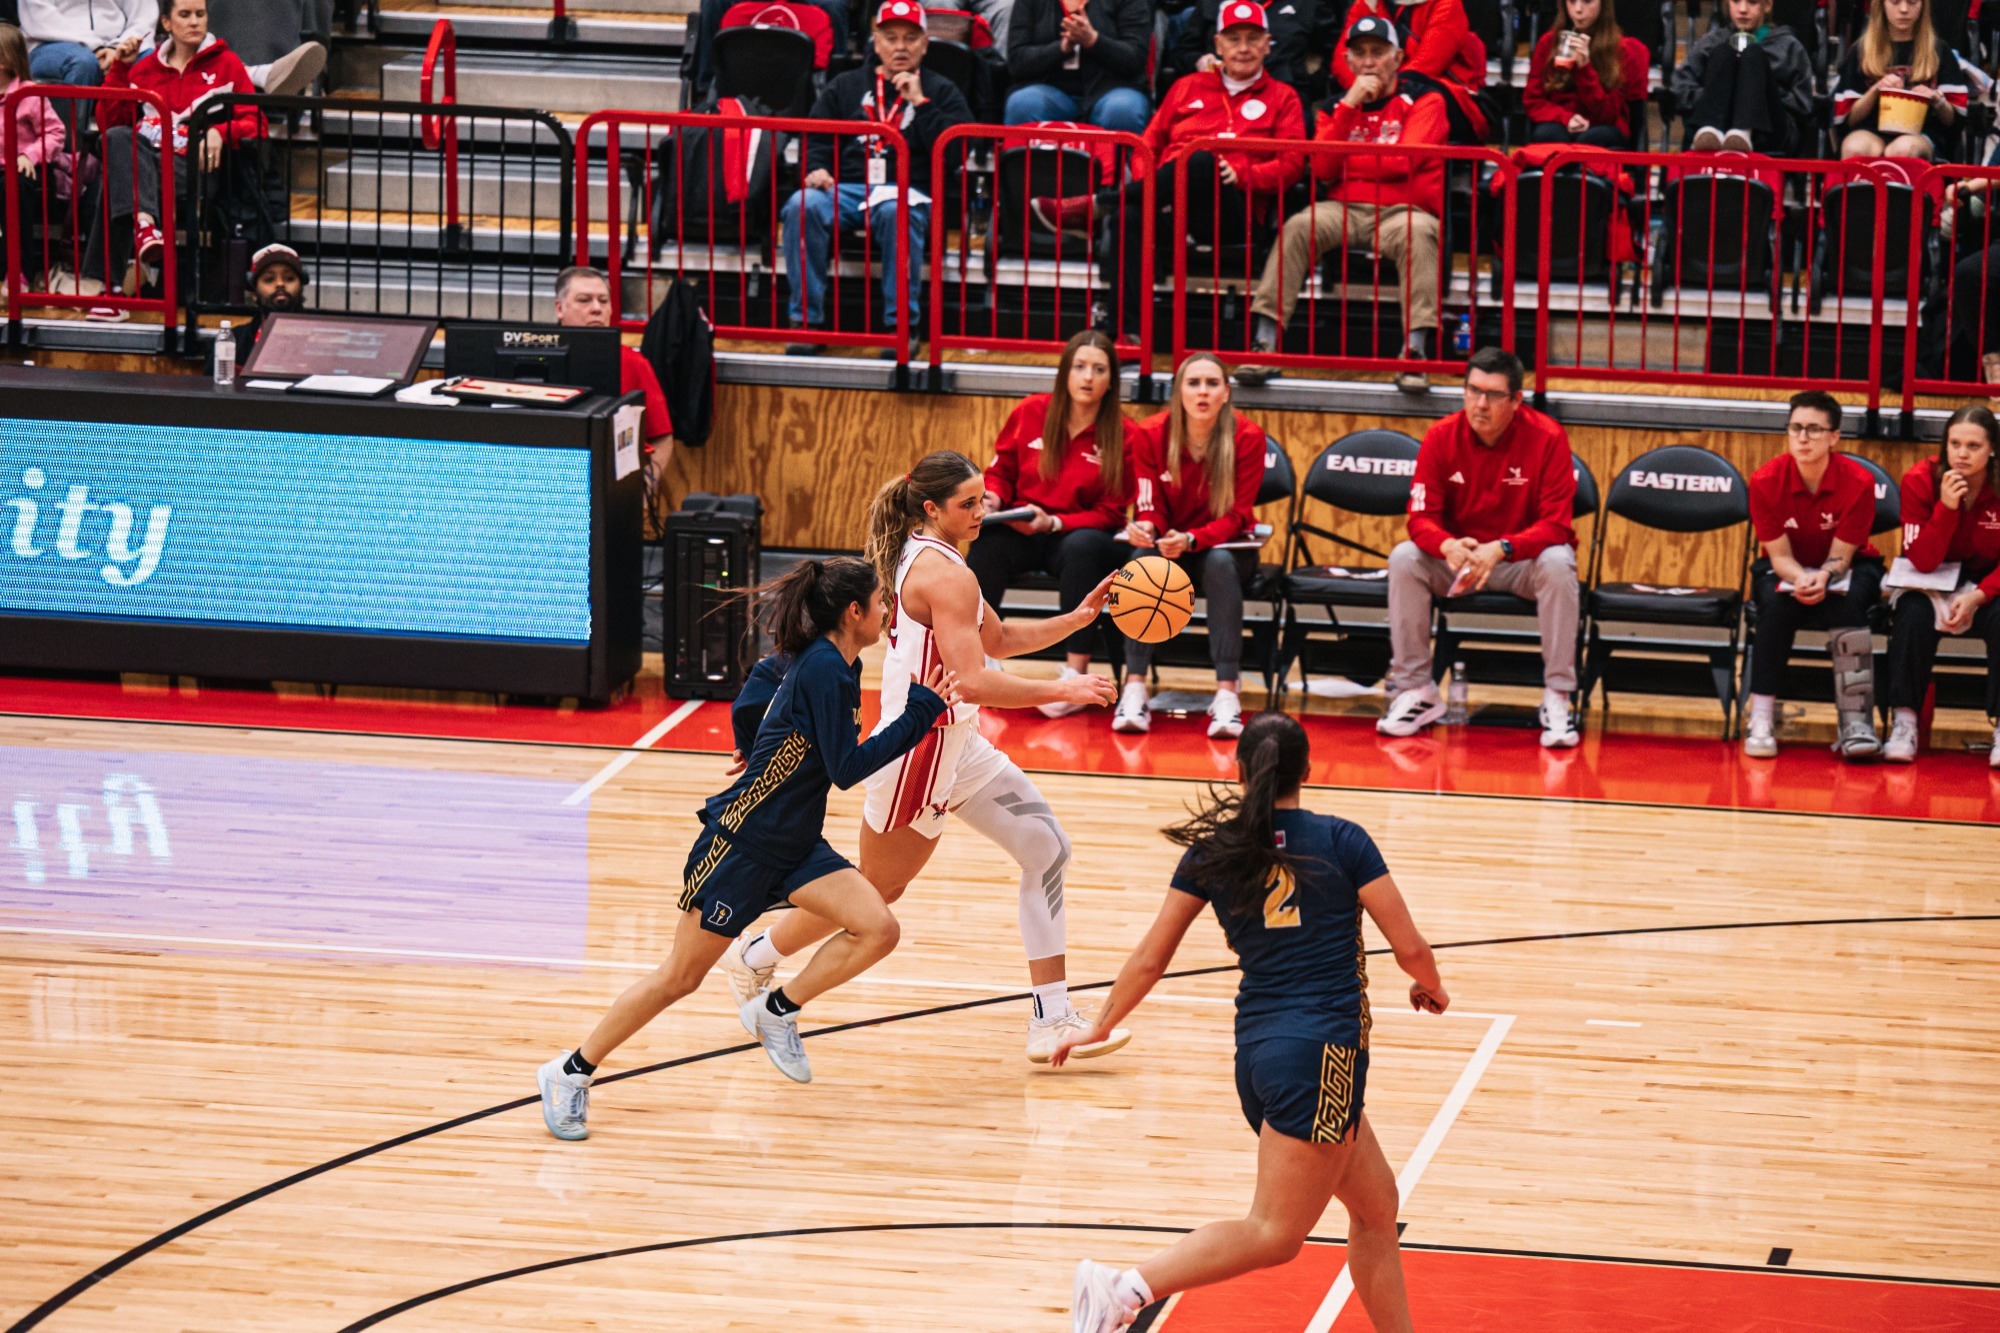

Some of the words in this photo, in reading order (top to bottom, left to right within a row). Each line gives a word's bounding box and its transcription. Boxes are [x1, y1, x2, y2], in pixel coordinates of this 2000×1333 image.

[1629, 470, 1733, 493] EASTERN
[5, 467, 173, 586] ity
[1263, 863, 1302, 930] 2
